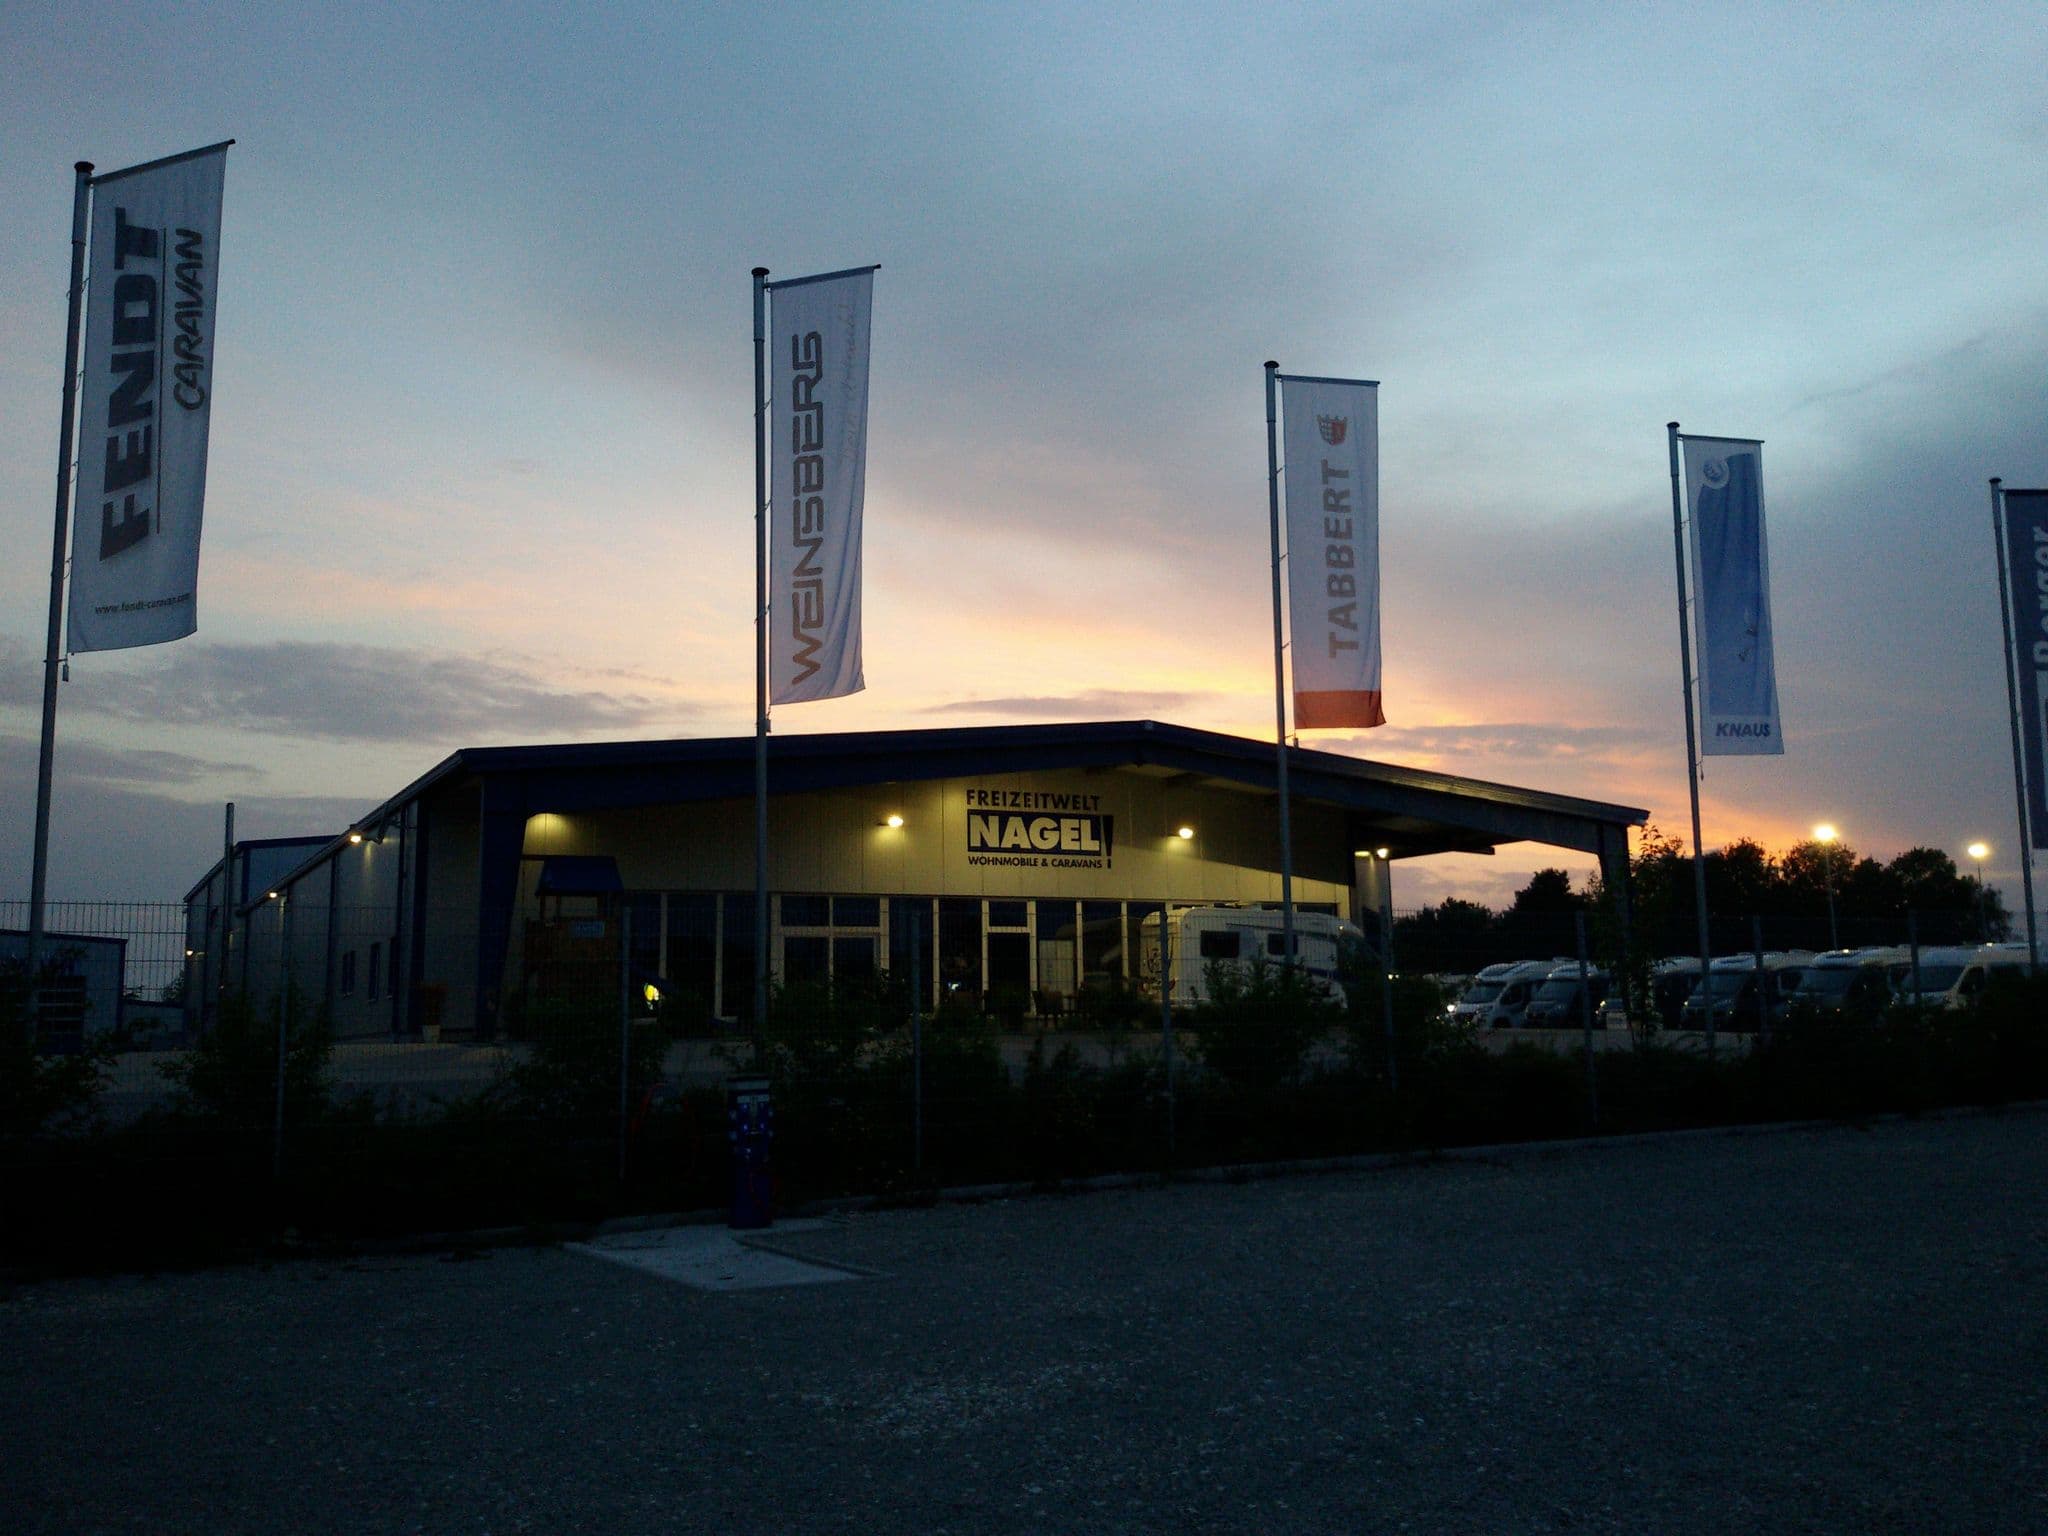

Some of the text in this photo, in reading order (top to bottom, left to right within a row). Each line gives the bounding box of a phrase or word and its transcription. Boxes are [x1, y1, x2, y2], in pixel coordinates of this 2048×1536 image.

[99, 207, 158, 562] FENDT
[173, 228, 205, 411] CARAVAN
[791, 330, 824, 686] WEINSBERG
[1321, 459, 1359, 659] TABBERT
[966, 789, 1100, 811] FREIZEITWELT
[1715, 722, 1770, 738] KNAUS
[968, 856, 1103, 869] WOHNMOBILE & CARAVANS
